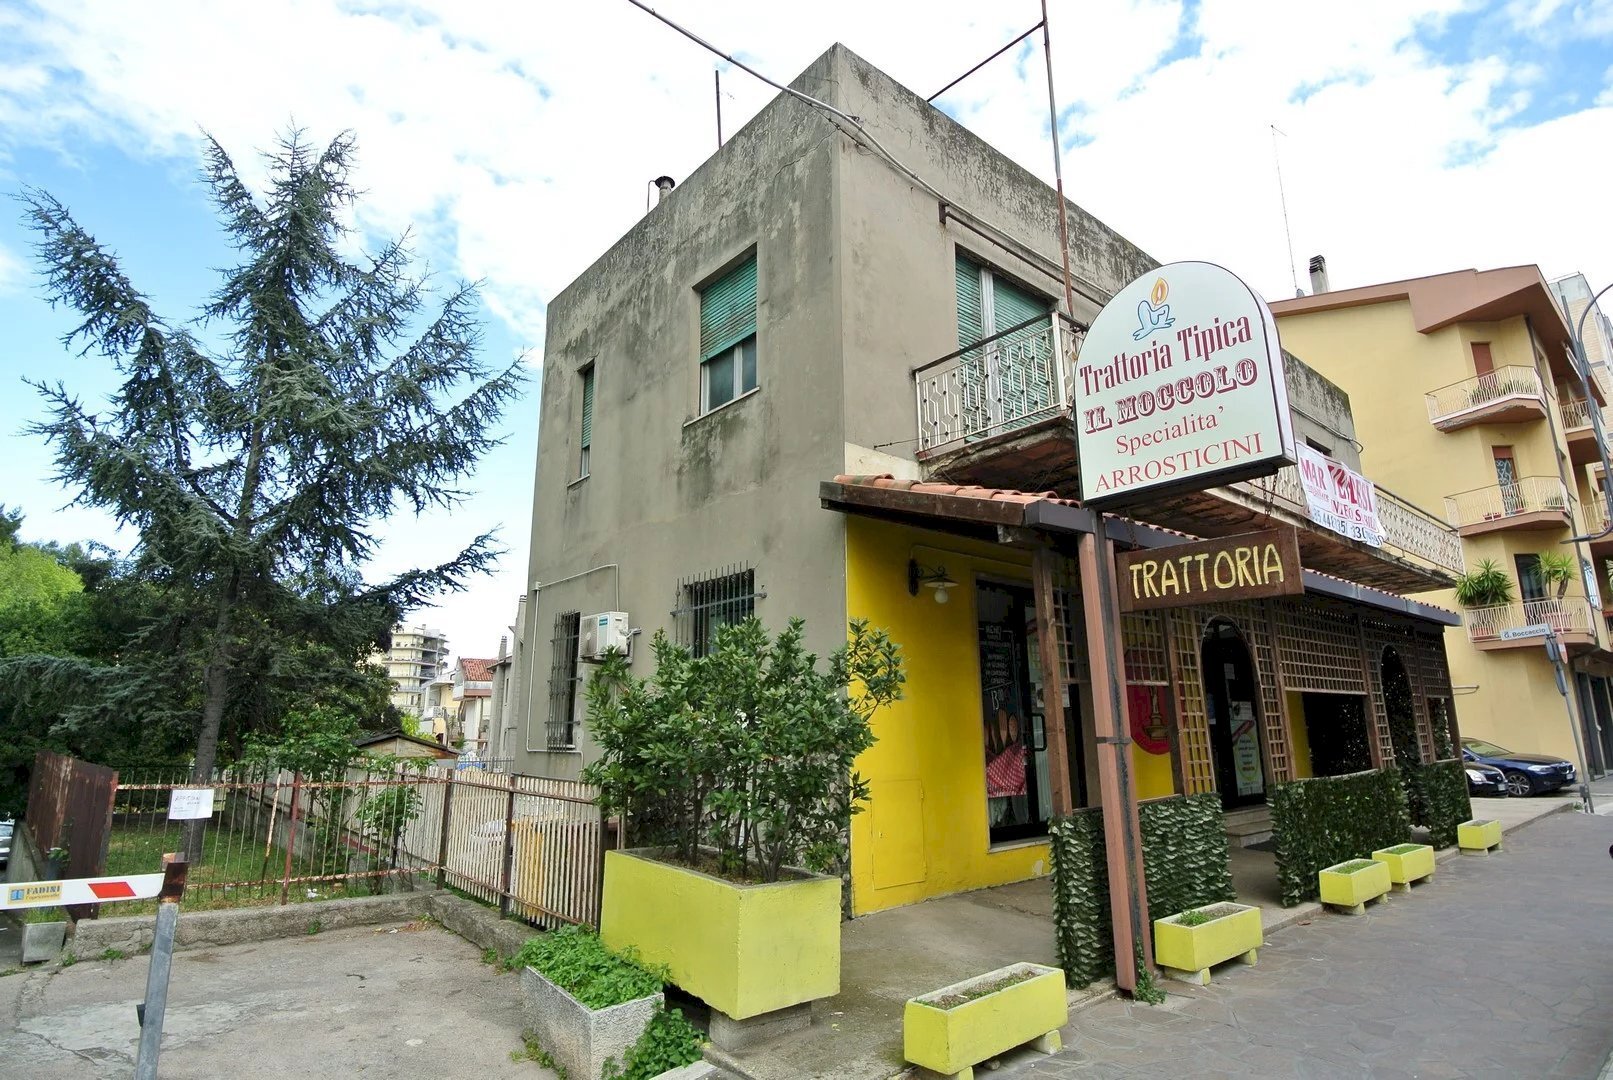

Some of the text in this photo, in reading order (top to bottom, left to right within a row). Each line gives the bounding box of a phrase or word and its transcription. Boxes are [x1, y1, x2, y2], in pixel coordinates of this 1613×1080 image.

[1079, 316, 1253, 396] Trattoria Tipica
[1083, 358, 1258, 434] IL MOCCOLO
[1095, 433, 1263, 493] ARROSTICINI
[1129, 543, 1284, 599] TRATTORIA
[1512, 628, 1546, 638] Boccaccio
[26, 885, 61, 895] FADINI
